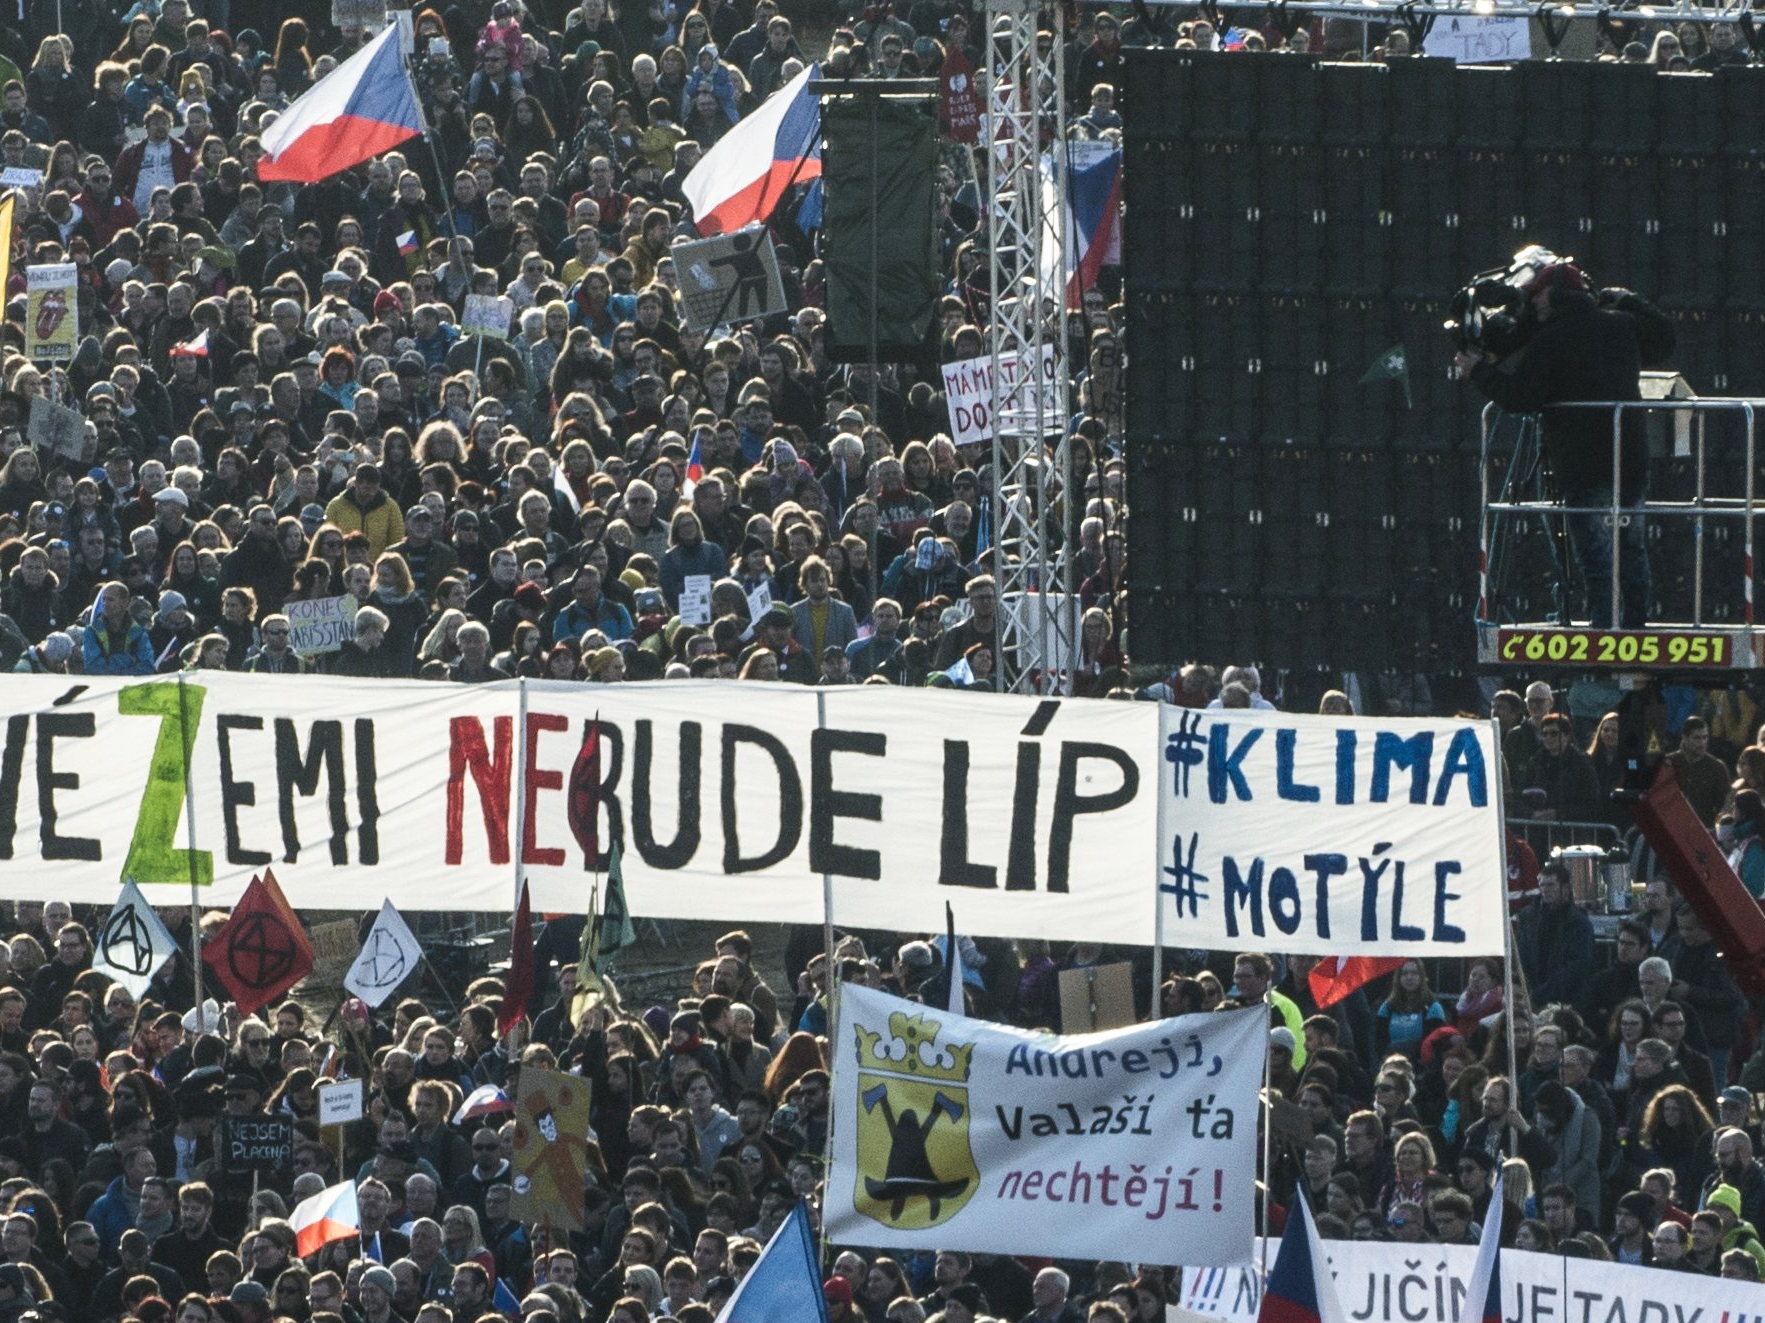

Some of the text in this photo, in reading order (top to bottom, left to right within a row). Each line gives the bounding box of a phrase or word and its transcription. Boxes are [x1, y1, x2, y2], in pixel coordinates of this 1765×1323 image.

[288, 597, 348, 619] KONEC
[1526, 633, 1724, 662] 602 205 951
[1164, 707, 1490, 809] #KLIMA
[117, 682, 382, 887] ZEMI
[444, 711, 887, 881] NEBUDE
[937, 700, 1141, 894] LÍP
[1158, 831, 1467, 946] #MOTÝLE
[1005, 1034, 1224, 1081] Andreji,
[1186, 1093, 1234, 1142] ťa
[996, 1159, 1225, 1220] nechtějí!
